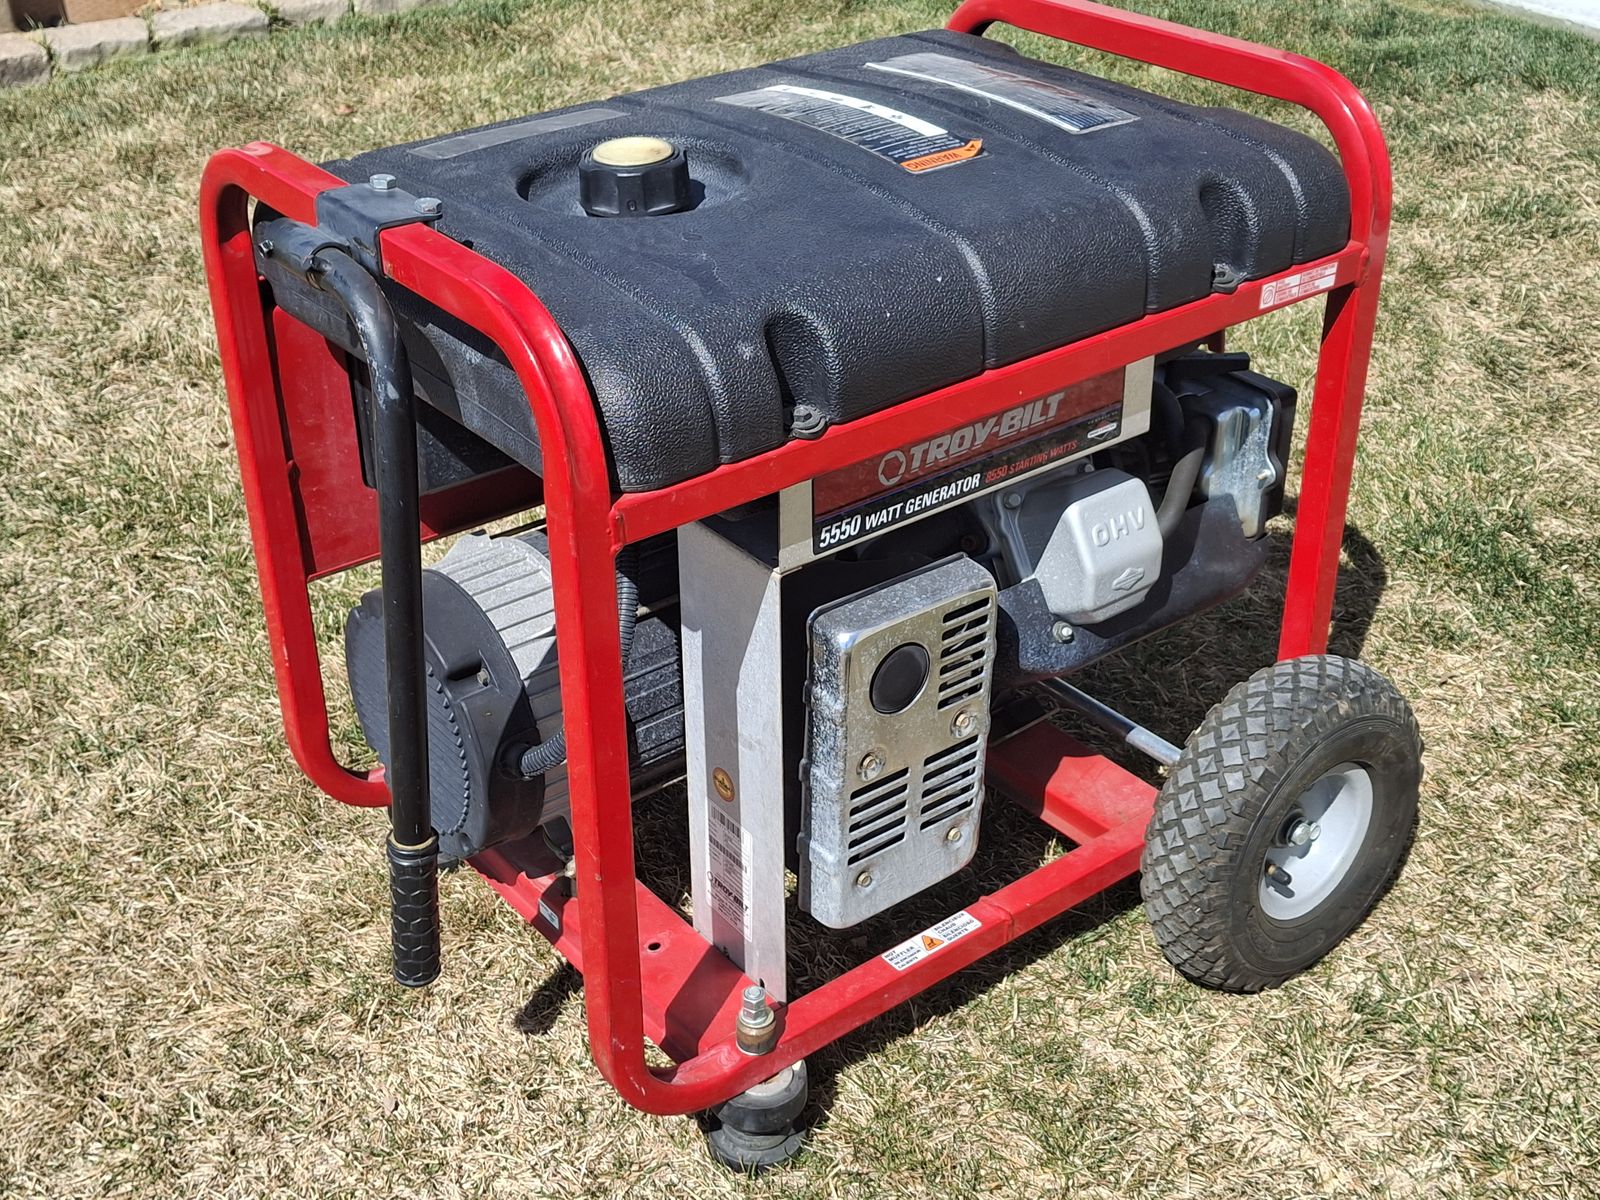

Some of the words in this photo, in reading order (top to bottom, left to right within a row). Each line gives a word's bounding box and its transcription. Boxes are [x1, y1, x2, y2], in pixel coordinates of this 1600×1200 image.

[905, 152, 962, 169] WARNING
[908, 393, 1065, 473] TROY-BILT
[819, 515, 861, 548] 5550
[865, 502, 904, 530] WATT
[905, 473, 981, 515] GENERATOR
[985, 465, 1008, 483] 8550
[1009, 451, 1048, 474] STARTING
[1050, 440, 1078, 459] WATTS
[1091, 506, 1145, 547] OHV
